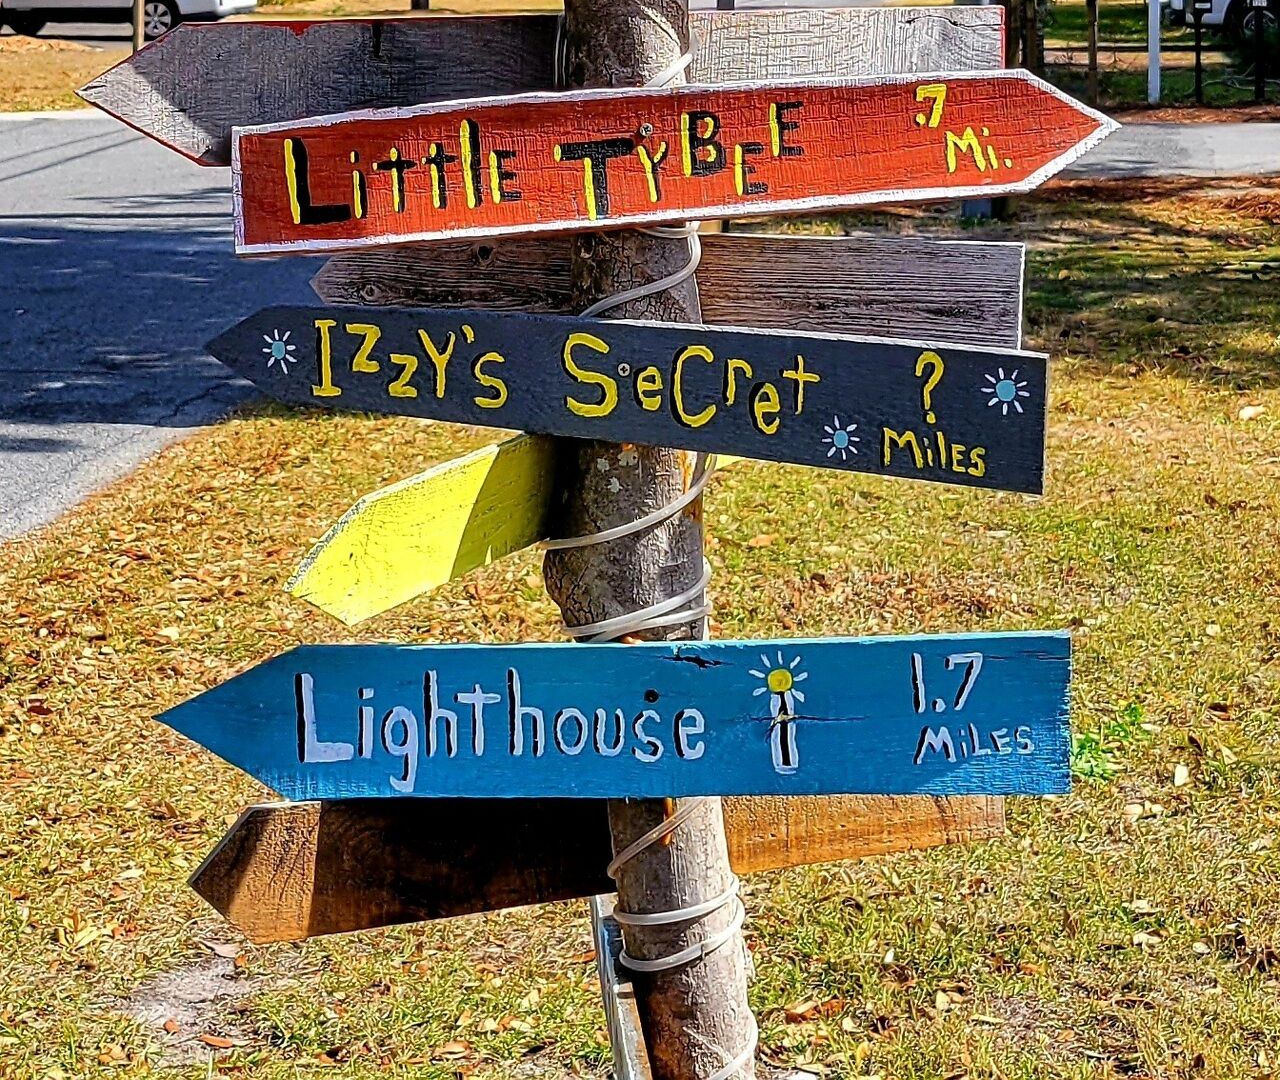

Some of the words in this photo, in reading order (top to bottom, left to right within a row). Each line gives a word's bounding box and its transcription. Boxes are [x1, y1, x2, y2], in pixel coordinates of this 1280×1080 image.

[915, 83, 947, 128] .7
[915, 350, 945, 425] ?
[911, 651, 984, 713] 1.7
[292, 666, 707, 792] Lighthouse
